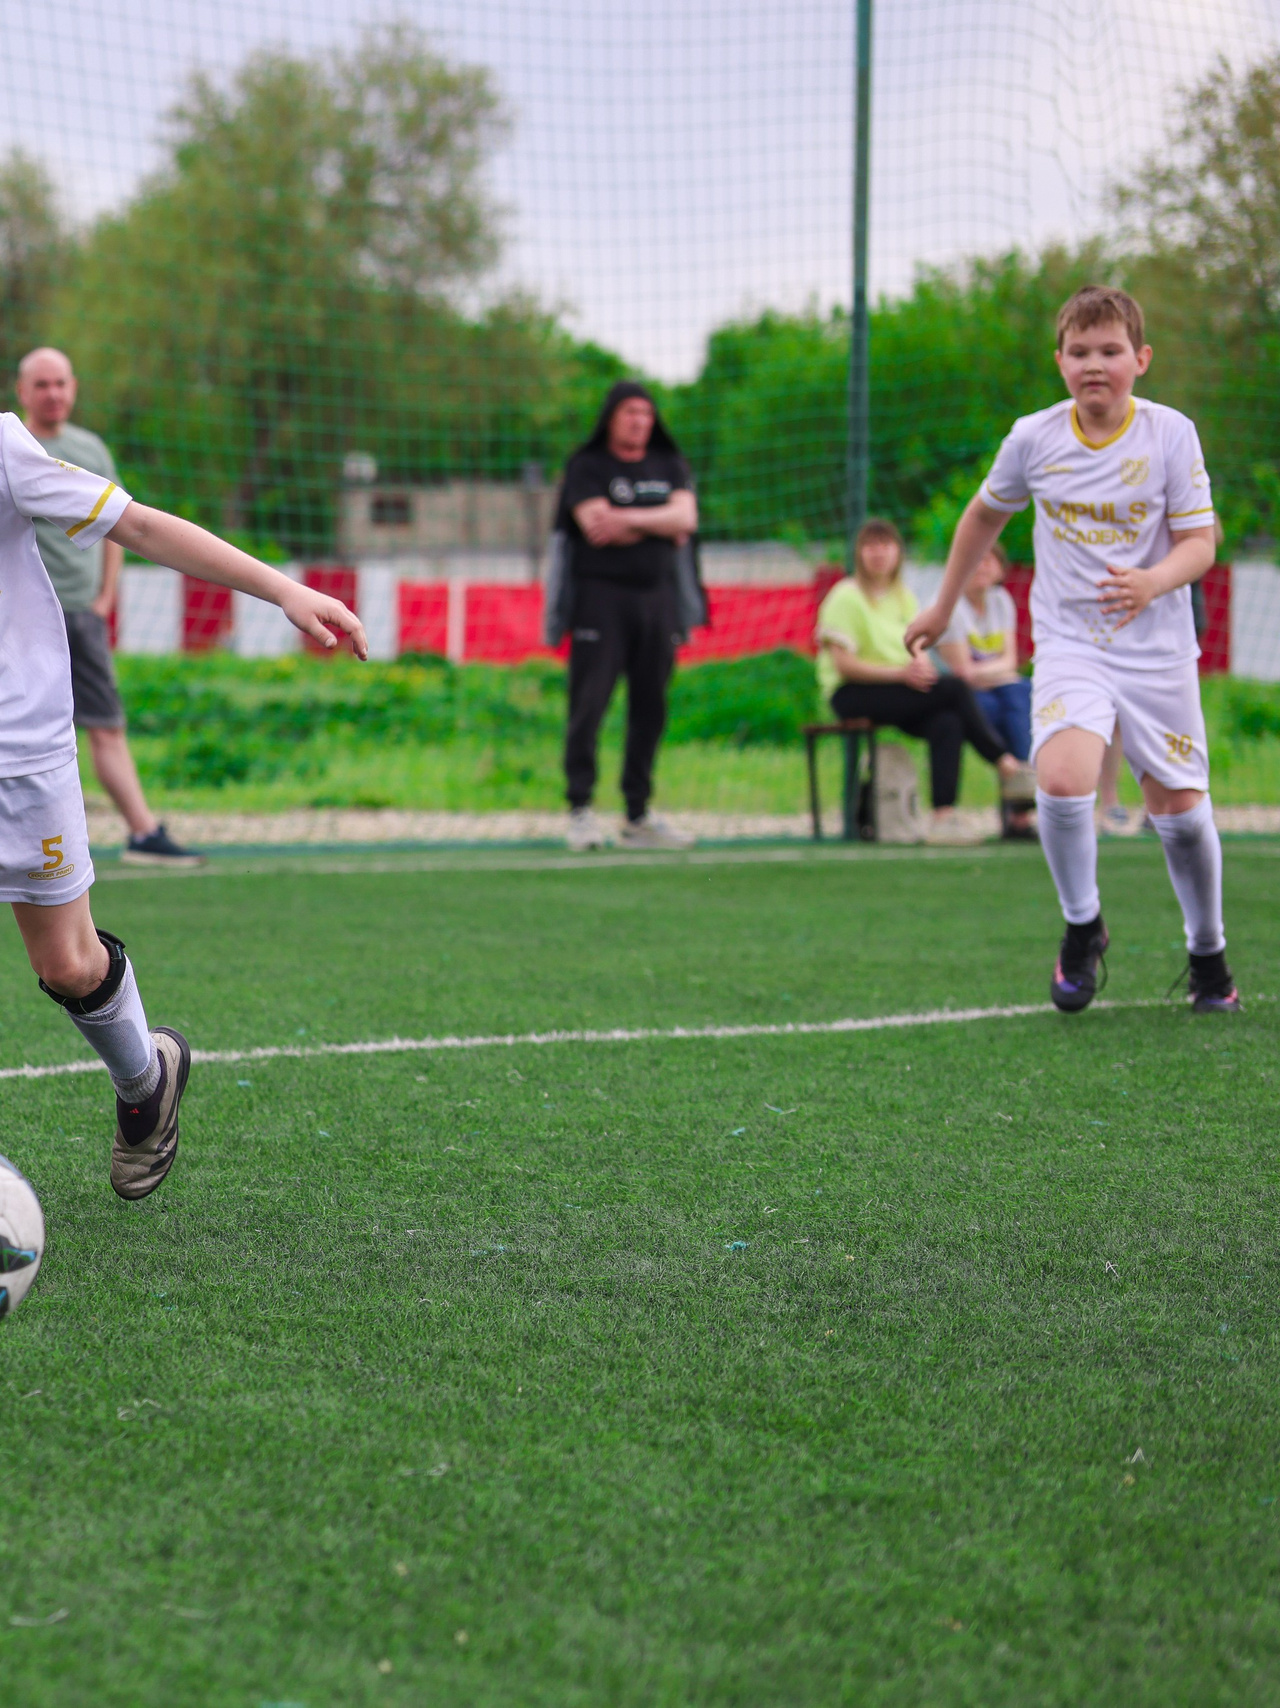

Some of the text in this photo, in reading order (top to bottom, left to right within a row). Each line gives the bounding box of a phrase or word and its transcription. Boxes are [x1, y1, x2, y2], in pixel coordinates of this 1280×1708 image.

[1041, 499, 1147, 524] MPULS
[1053, 526, 1139, 545] ACADEMY
[1164, 733, 1192, 756] 30
[41, 834, 63, 871] 5
